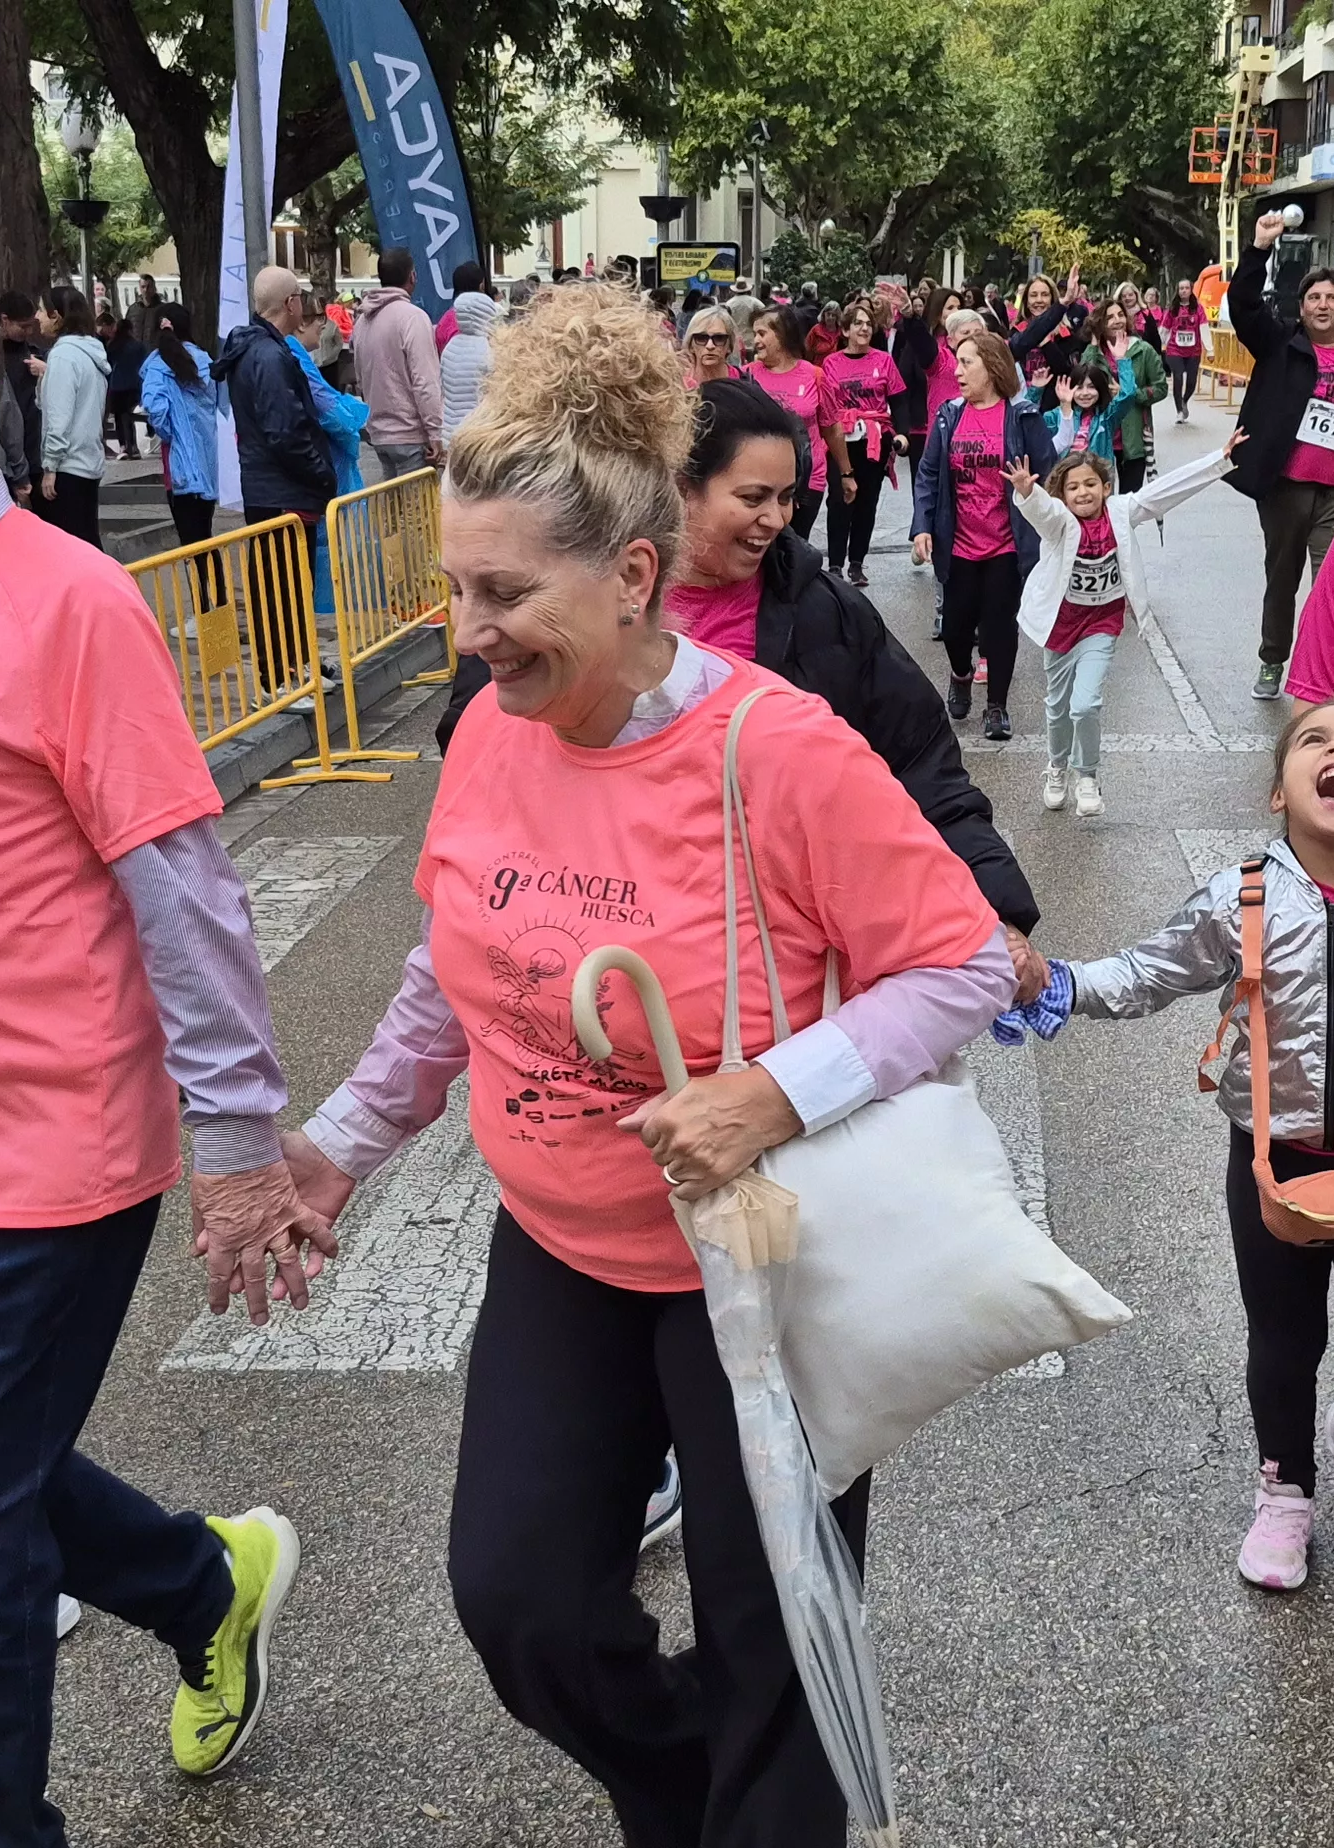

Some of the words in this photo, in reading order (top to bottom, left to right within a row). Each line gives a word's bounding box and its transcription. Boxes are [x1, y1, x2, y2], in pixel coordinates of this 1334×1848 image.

[1071, 565, 1119, 592] 3276
[537, 866, 637, 906] CÁNCER
[580, 901, 656, 928] HUESCA
